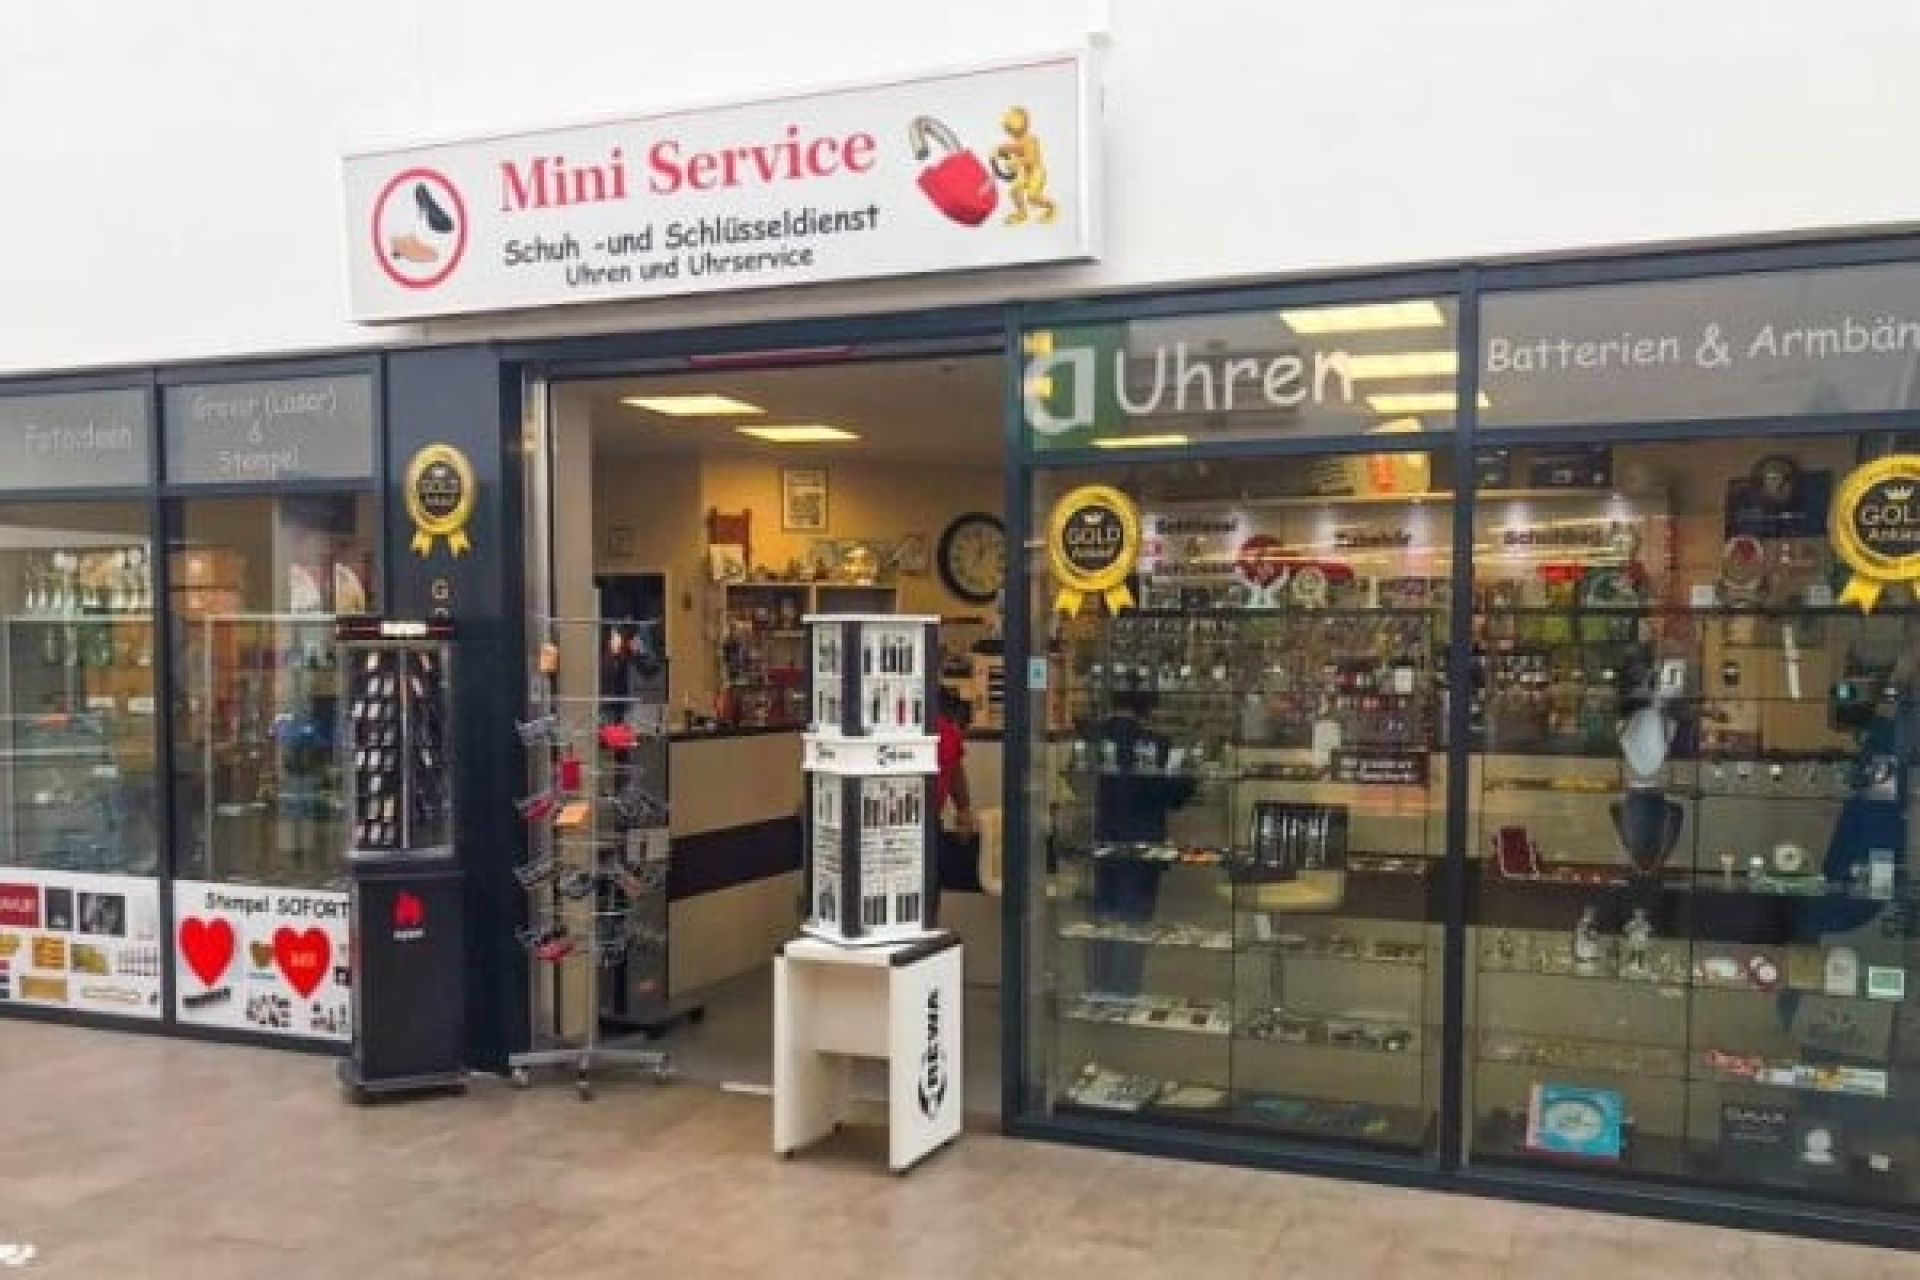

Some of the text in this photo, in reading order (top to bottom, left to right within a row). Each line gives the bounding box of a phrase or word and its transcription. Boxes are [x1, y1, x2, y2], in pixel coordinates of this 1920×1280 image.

[499, 122, 877, 214] Mini Service
[503, 232, 580, 267] Schuh
[665, 202, 881, 250] Schlüsseldienst
[564, 244, 816, 289] Uhren und Uhrservice
[1486, 332, 1681, 373] Batterien
[1695, 322, 1732, 369] &
[1115, 341, 1356, 415] Uhren
[1064, 527, 1122, 546] GOLD
[1861, 505, 1920, 526] GOL
[277, 895, 352, 920] SOFORT
